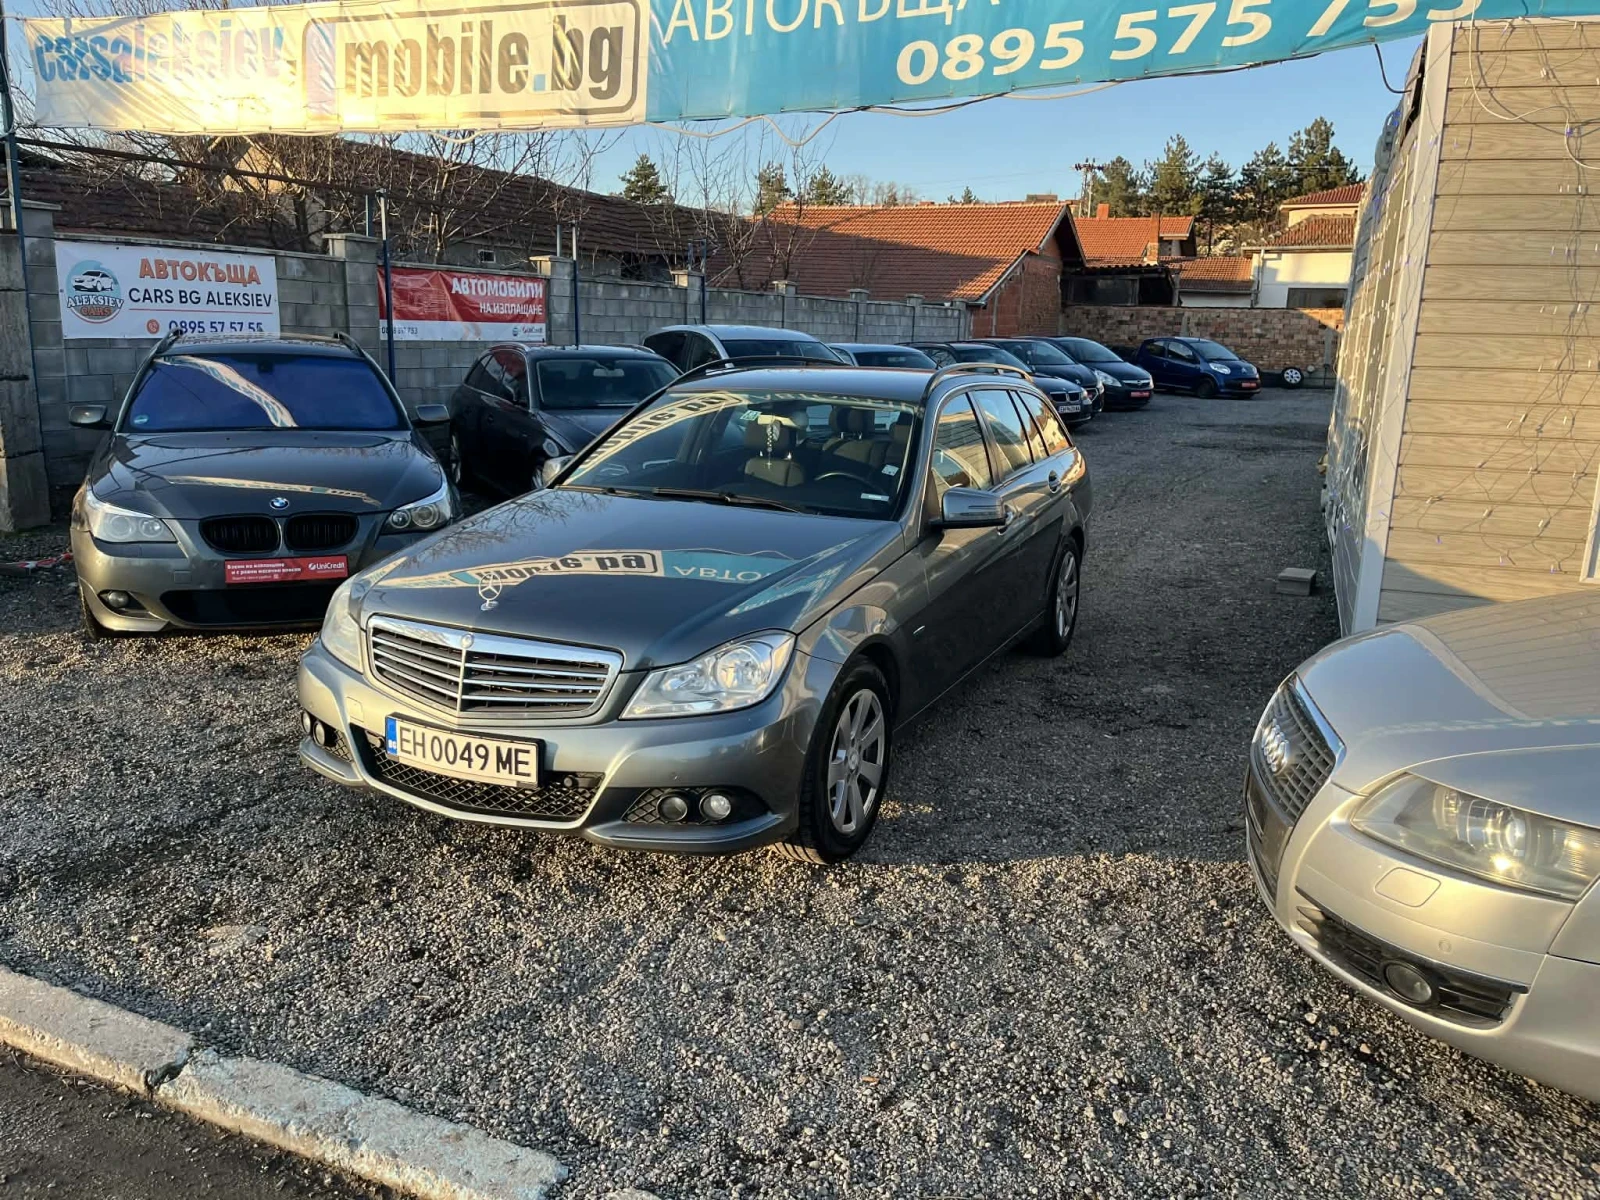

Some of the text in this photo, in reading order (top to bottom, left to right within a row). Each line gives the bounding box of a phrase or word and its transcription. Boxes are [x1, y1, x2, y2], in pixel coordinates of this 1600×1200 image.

[664, 0, 1001, 44] АВТО
[896, 20, 1084, 85] 0895
[1109, 0, 1272, 60] 575
[345, 14, 624, 100] mobile.bg
[139, 257, 261, 287] АВТОКЪЩА
[128, 287, 272, 308] CARS BG ALEKSIEV
[451, 277, 543, 299] АВТОМОБИЛИ
[67, 294, 124, 309] ALEKSIEV
[81, 305, 112, 316] CARS
[480, 302, 543, 317] НА ИЗПЛАЩАНЕ
[168, 320, 205, 334] 0895
[210, 321, 225, 333] 57
[230, 322, 244, 332] 57
[316, 562, 345, 570] UniCredit
[400, 727, 426, 759] EH
[430, 735, 490, 771] 0049
[496, 745, 532, 777] ME
